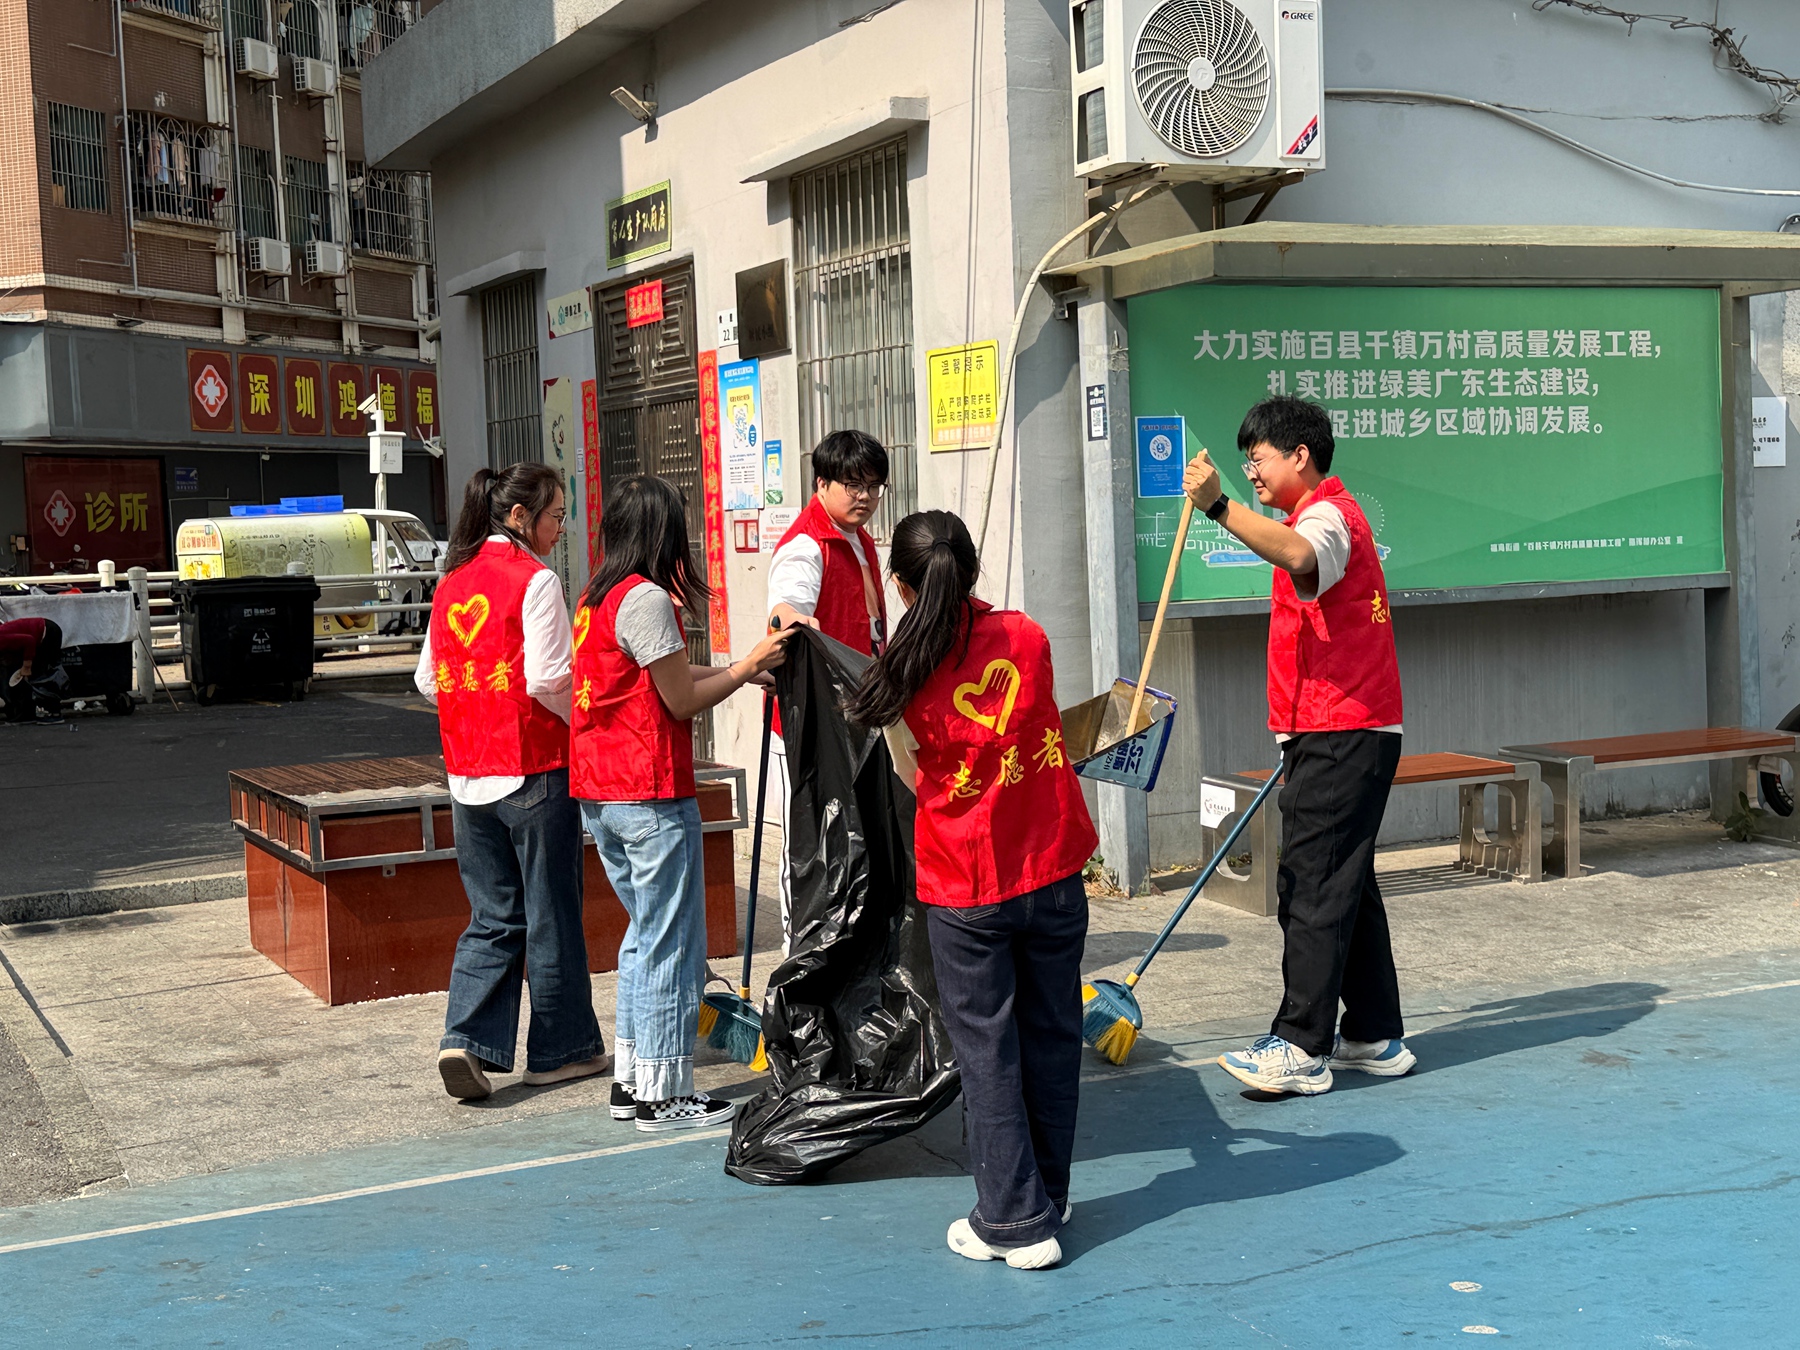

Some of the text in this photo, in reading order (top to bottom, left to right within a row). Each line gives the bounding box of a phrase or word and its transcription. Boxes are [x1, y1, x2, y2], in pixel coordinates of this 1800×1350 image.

[1290, 12, 1314, 20] GREE
[1194, 329, 1661, 361] 大力实施百县千镇万村高质量发展工程，
[248, 372, 434, 425] 深圳鸿德福
[1267, 367, 1599, 400] 扎实推进绿美广东生态建设，
[85, 492, 148, 533] 诊所
[1371, 590, 1391, 623] 志
[435, 660, 513, 693] 志愿者
[574, 674, 592, 712] 者
[947, 728, 1064, 802] 志愿者
